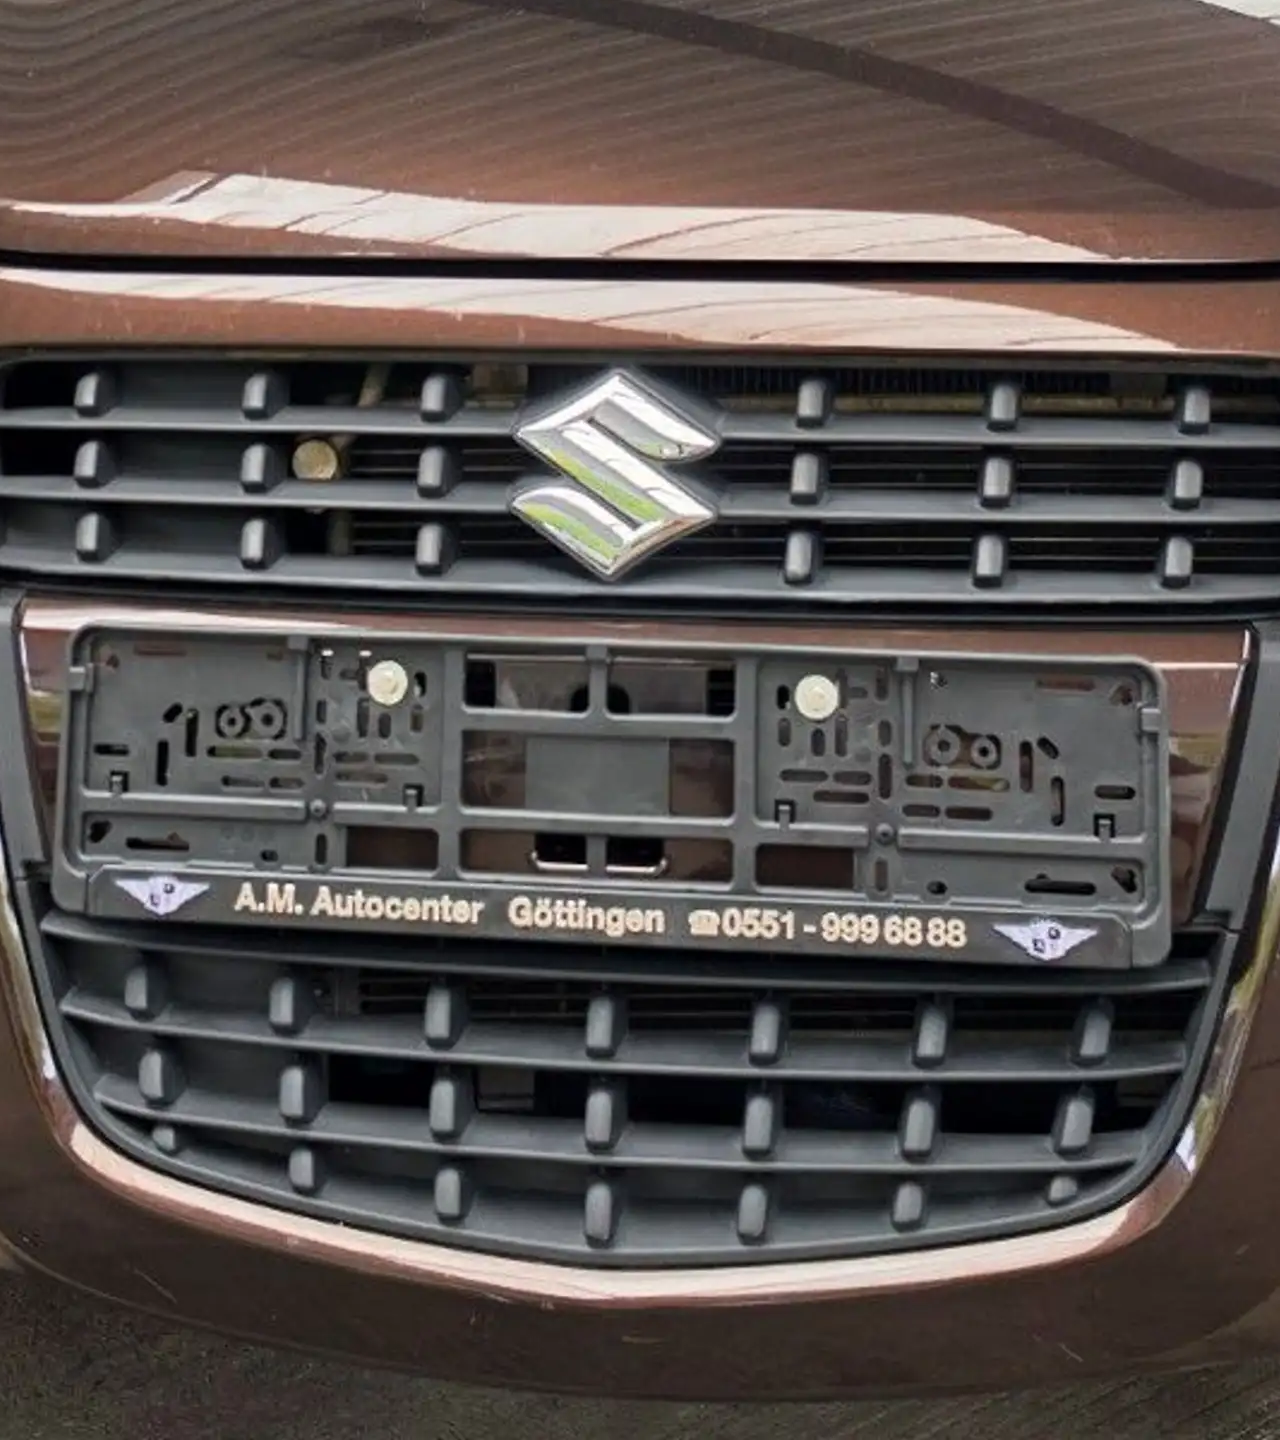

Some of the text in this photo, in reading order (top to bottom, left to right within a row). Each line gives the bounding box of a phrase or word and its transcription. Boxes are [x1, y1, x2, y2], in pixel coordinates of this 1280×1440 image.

[234, 881, 304, 915] A.M.
[311, 885, 485, 925] Autocenter
[507, 894, 666, 937] Göttingen
